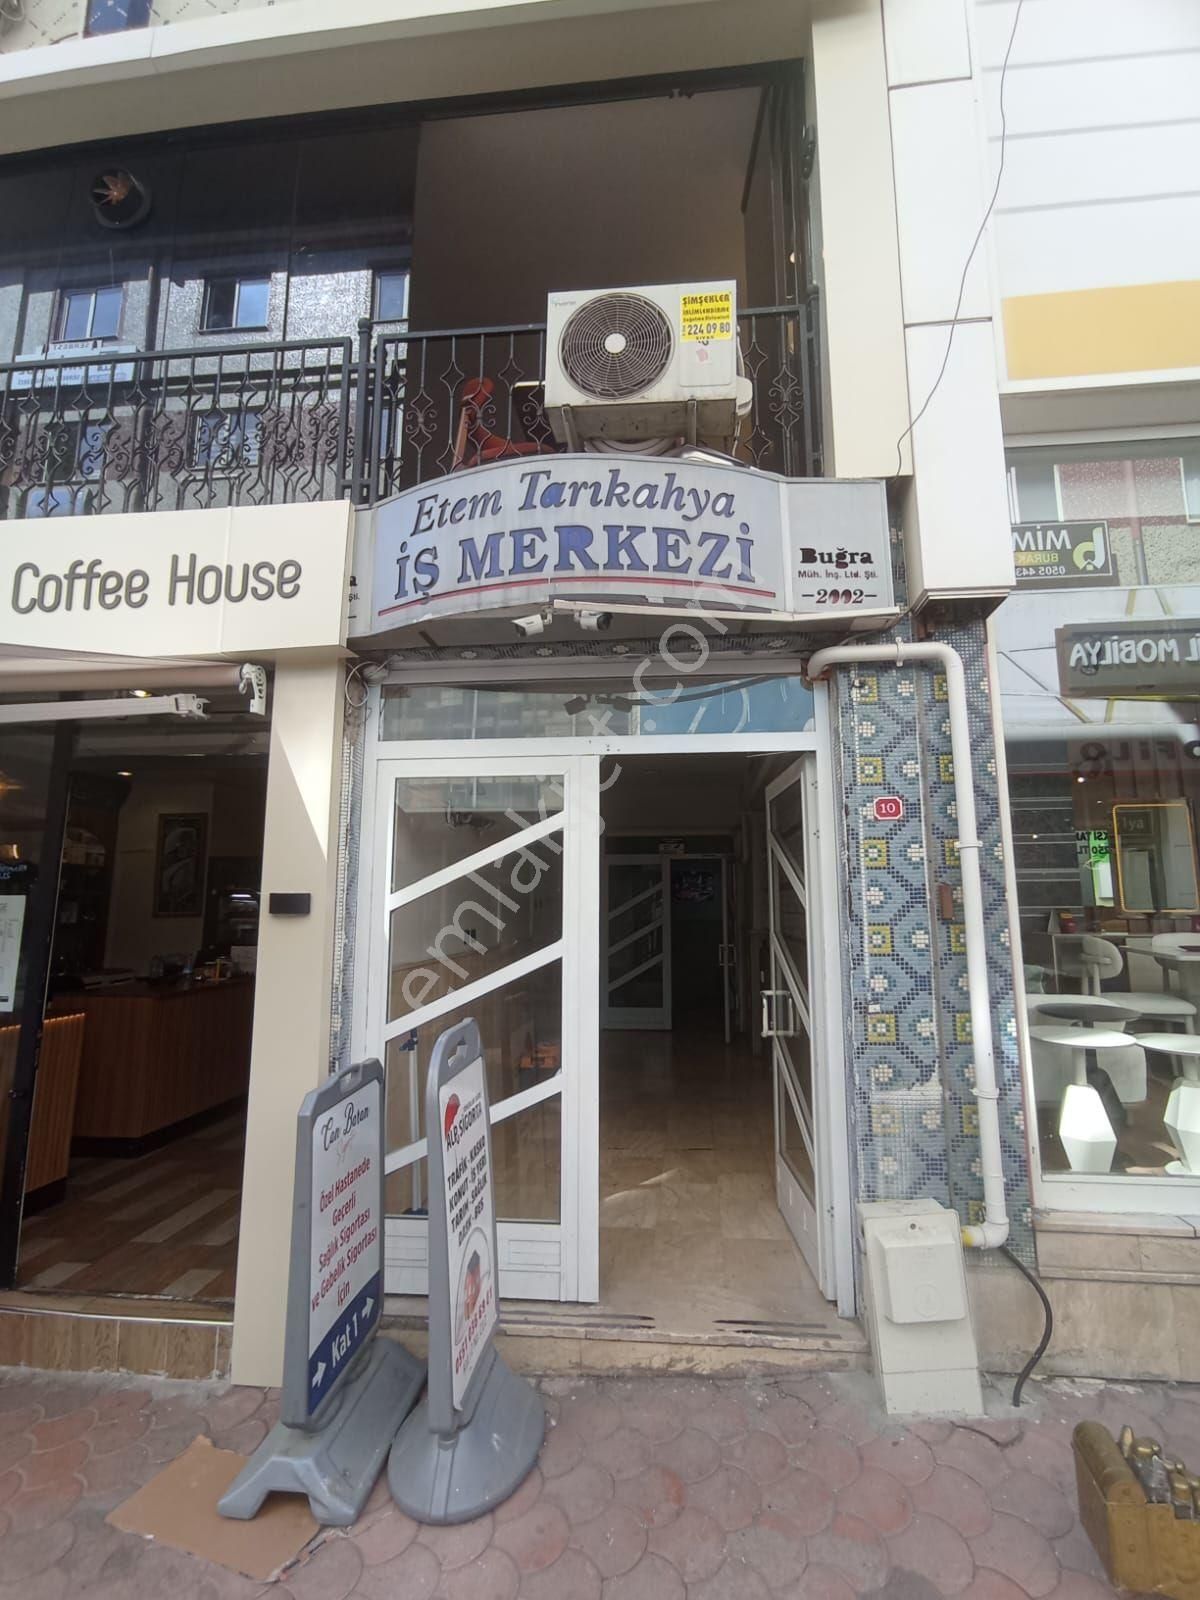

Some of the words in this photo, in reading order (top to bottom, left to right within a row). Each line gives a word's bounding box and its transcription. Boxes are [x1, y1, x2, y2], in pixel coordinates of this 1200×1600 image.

[687, 324, 704, 336] 224
[706, 322, 718, 334] 09
[719, 322, 731, 333] 80
[411, 488, 502, 537] Etem
[518, 468, 736, 522] Tarıkahya
[394, 541, 441, 604] İŞ
[457, 522, 756, 584] MERKEZİ
[797, 570, 822, 578] Müh.
[844, 570, 861, 579] Ltd.
[799, 547, 874, 569] Buğra
[11, 558, 150, 615] Coffee
[168, 552, 302, 606] House
[879, 802, 896, 814] 10
[321, 1116, 340, 1151] Can
[320, 1183, 334, 1214] Özel
[335, 1157, 371, 1199] Hastanede
[331, 1191, 356, 1227] Geçerli
[339, 1207, 371, 1247] Sigortası
[320, 1256, 346, 1299] Gebelik
[346, 1226, 378, 1266] Sigortası
[331, 1322, 352, 1369] Kat
[352, 1311, 359, 1337] 1
